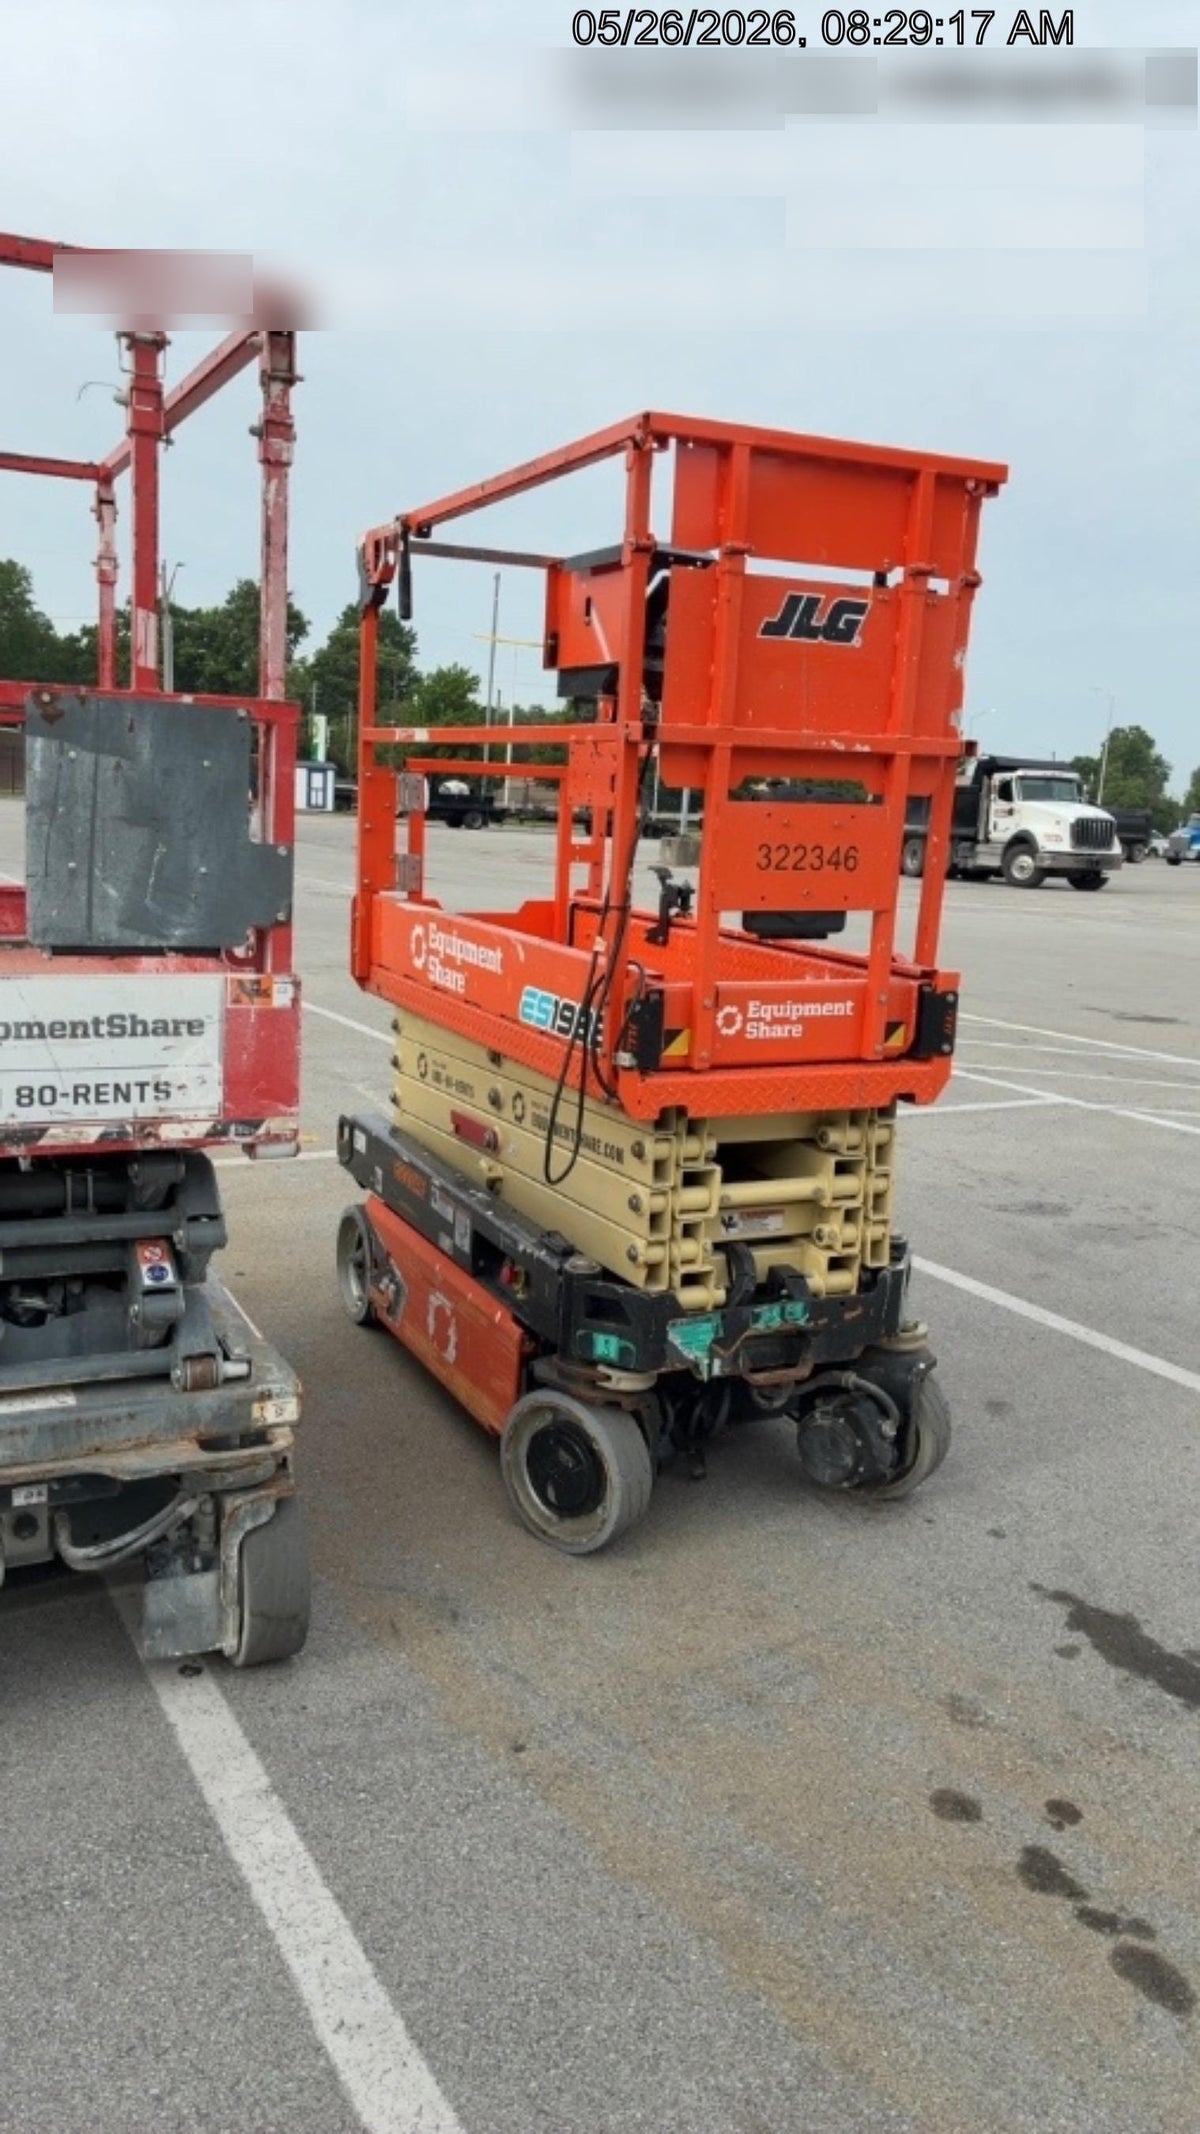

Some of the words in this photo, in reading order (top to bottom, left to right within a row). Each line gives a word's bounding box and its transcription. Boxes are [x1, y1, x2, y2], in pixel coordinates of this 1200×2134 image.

[757, 590, 872, 648] JLG
[755, 842, 860, 873] 322346
[428, 922, 503, 976] Equipment
[427, 954, 466, 995] Share
[746, 1000, 854, 1022] Equipment
[745, 1022, 802, 1040] Share
[15, 1080, 172, 1108] 80-RENTS
